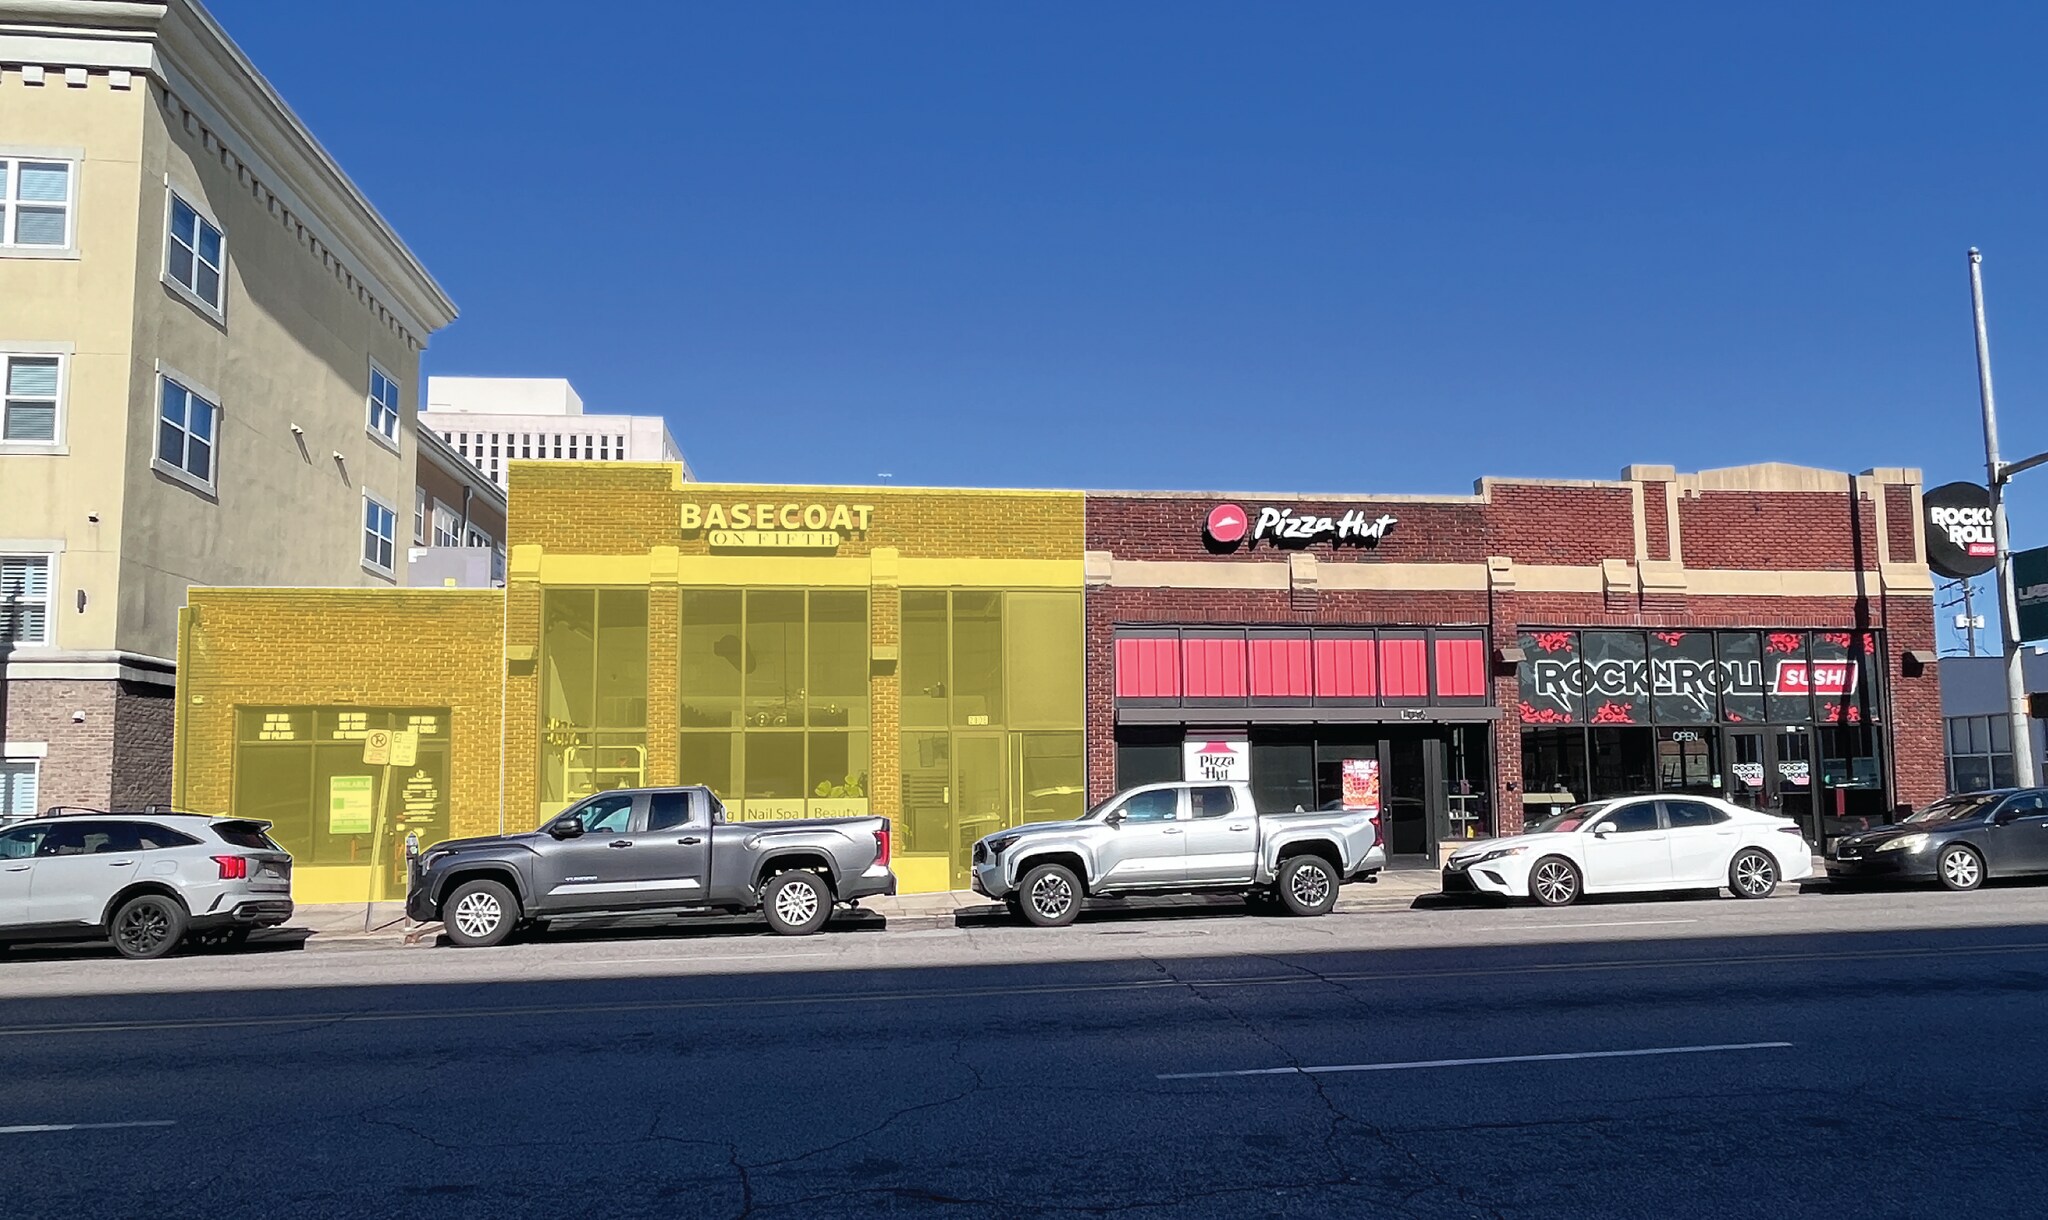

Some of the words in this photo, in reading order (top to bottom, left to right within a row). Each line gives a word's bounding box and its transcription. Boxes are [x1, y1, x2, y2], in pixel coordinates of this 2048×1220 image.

[680, 503, 874, 530] BASECOAT
[1254, 507, 1335, 539] Pizza
[1336, 509, 1398, 538] Hut
[714, 533, 746, 545] ON
[758, 533, 833, 545] FIFTH
[1948, 525, 1995, 551] ROLL
[1535, 659, 1652, 712] ROCK
[1673, 660, 1770, 711] ROLL
[1786, 669, 1849, 687] SUSHI
[1672, 731, 1698, 742] OPEN
[1200, 754, 1235, 768] Pizza
[1200, 766, 1228, 781] Hut
[748, 808, 773, 819] Nail
[776, 808, 799, 820] Spa
[814, 807, 859, 819] Beauty
